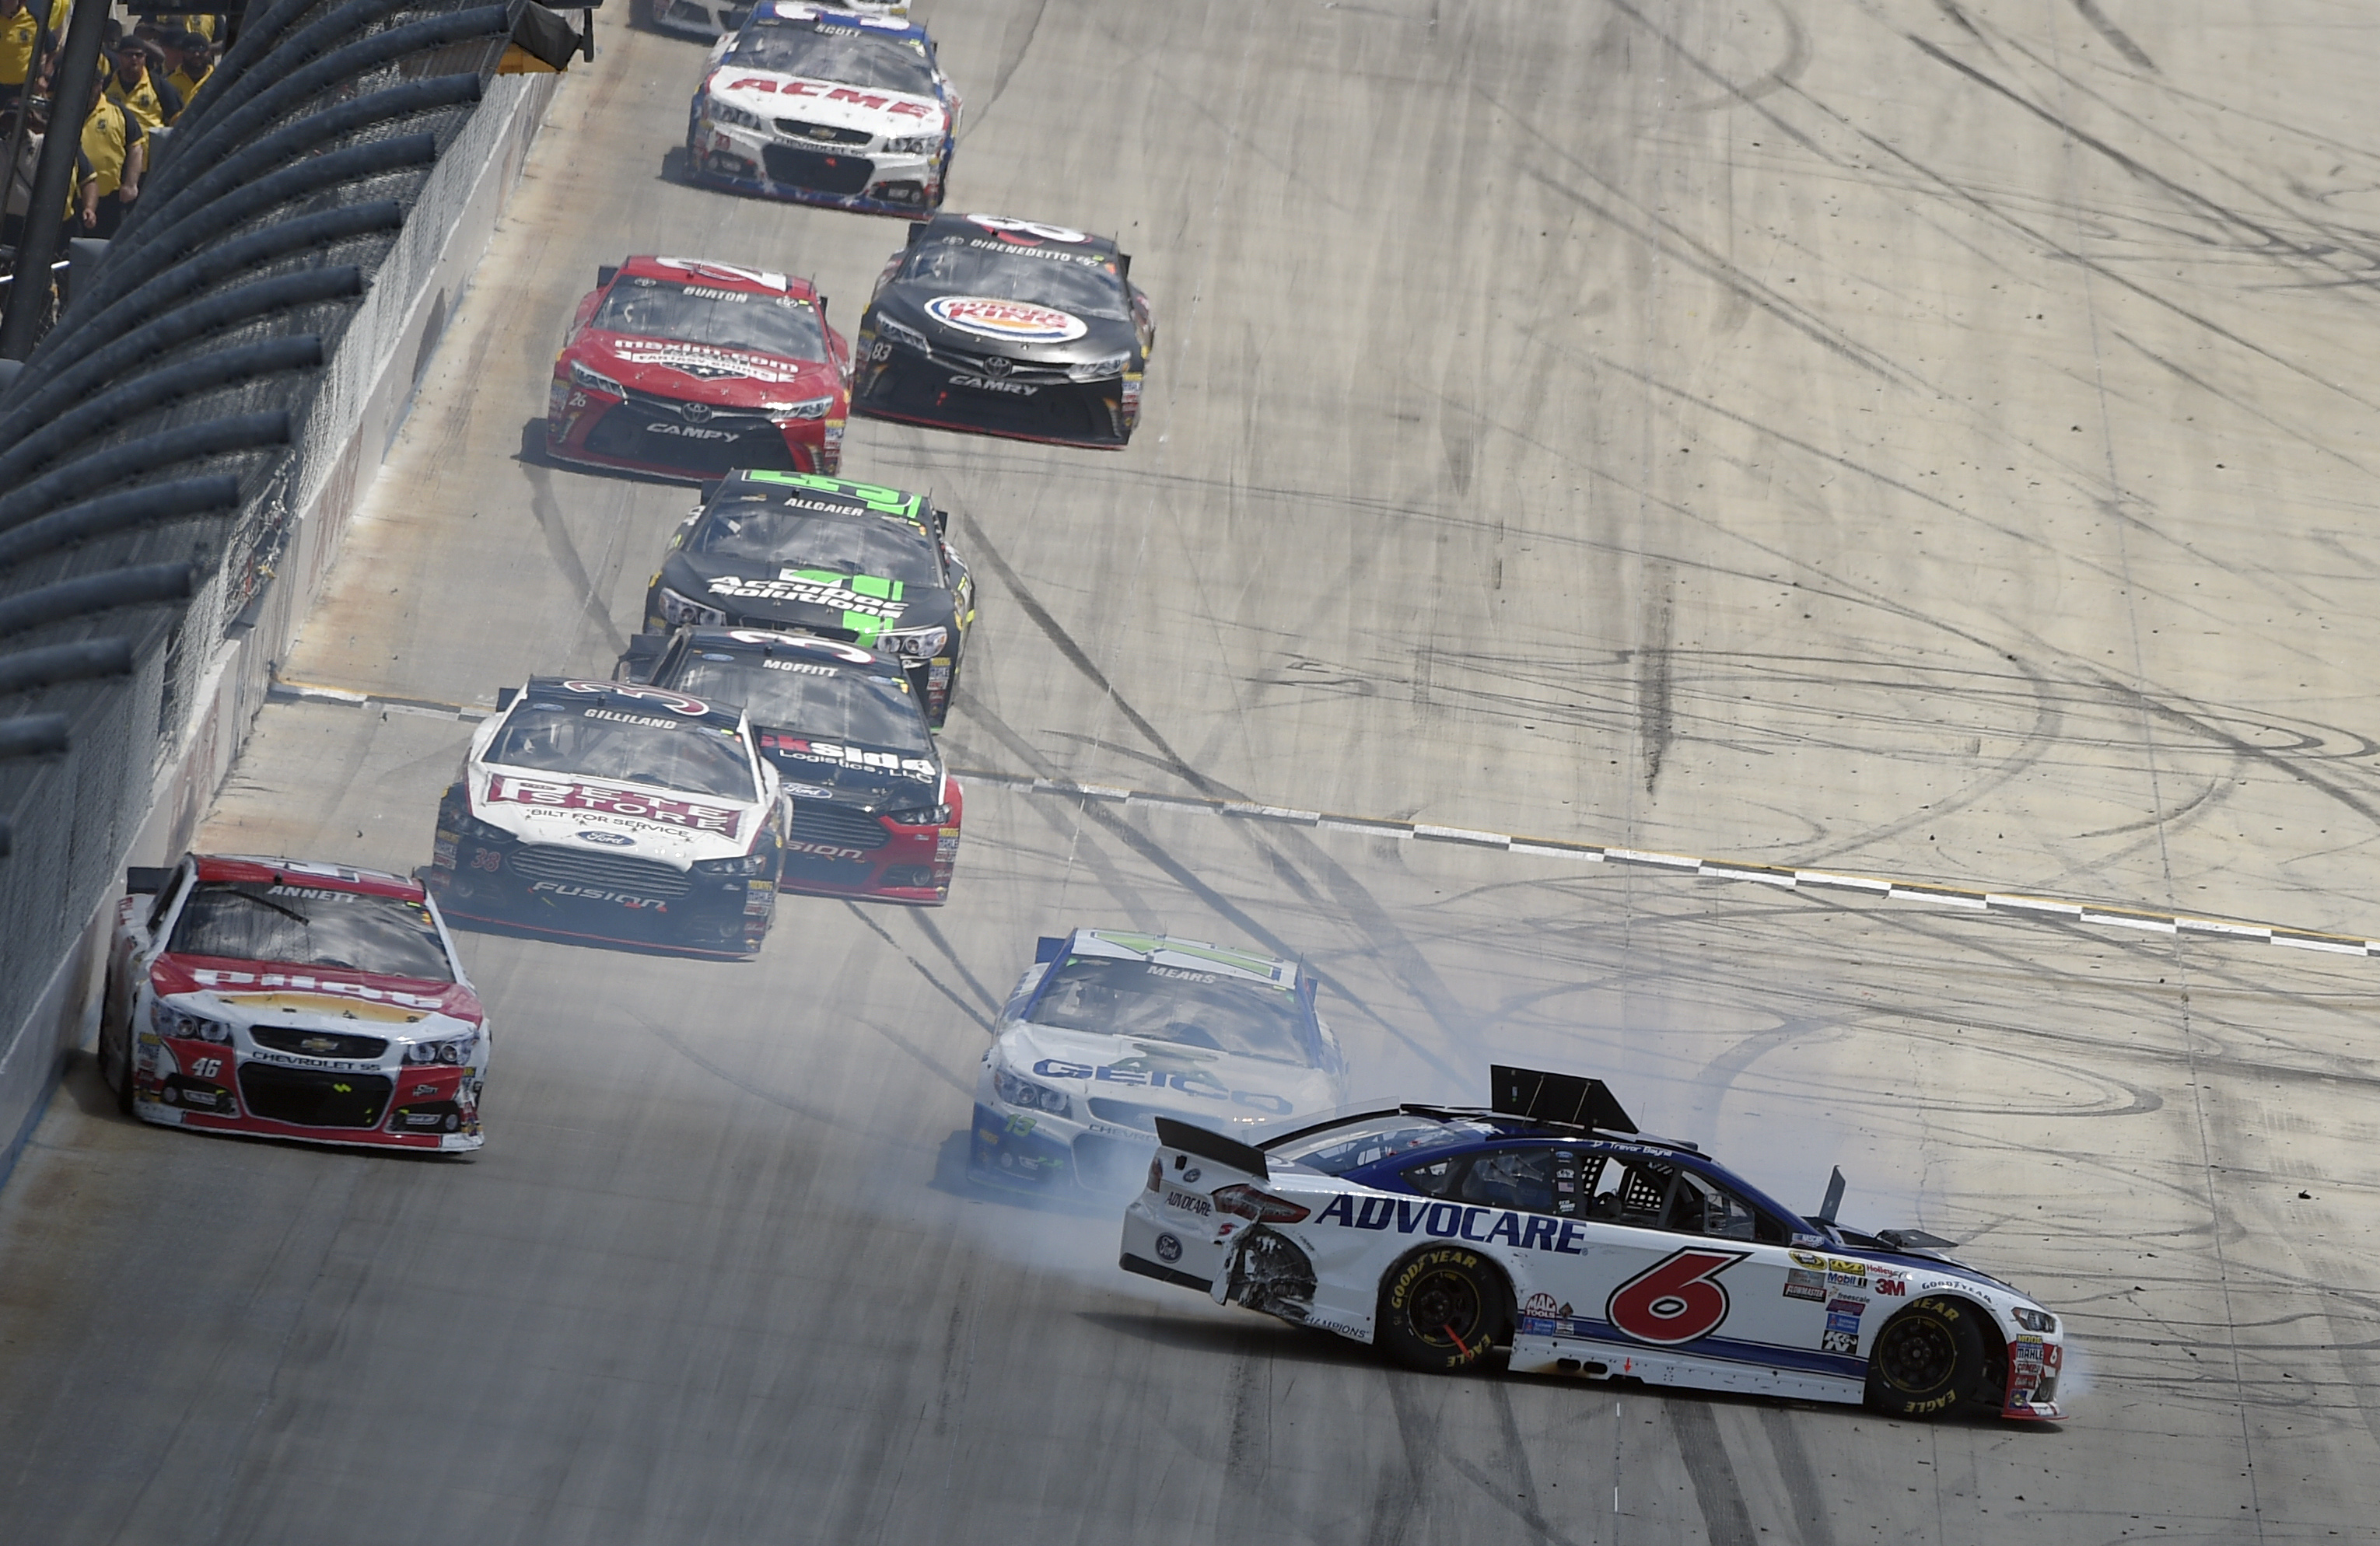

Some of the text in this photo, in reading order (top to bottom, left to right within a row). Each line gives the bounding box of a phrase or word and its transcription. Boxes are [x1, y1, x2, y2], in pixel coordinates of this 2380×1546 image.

[815, 23, 863, 37] SCOTT
[725, 78, 933, 119] ACME
[970, 237, 1071, 262] DIBENEDETTO
[683, 285, 748, 303] BURTON
[871, 342, 892, 362] 83
[948, 375, 1038, 397] CAMRY
[569, 391, 588, 407] 26
[784, 496, 865, 516] ALLGAIER
[762, 659, 838, 677] MOFFITT
[584, 708, 677, 730] GILLILAND
[889, 768, 933, 784] LLC
[499, 777, 730, 817] PETE
[530, 790, 729, 833] STORE
[572, 813, 608, 824] FOR
[471, 846, 502, 873] 38
[787, 840, 863, 859] SION
[267, 885, 359, 904] ANNETT
[532, 880, 667, 911] FUSION
[1146, 965, 1217, 985] MEARS
[191, 1057, 223, 1079] 46
[251, 1051, 382, 1072] CHEVROLET SS
[1032, 1058, 1293, 1116] GEICO
[1004, 1113, 1037, 1136] 13
[1608, 1142, 1673, 1157] Trevor Bayne
[1164, 1191, 1213, 1218] ADVOCARE
[1313, 1194, 1587, 1255] ADVOCARE
[1391, 1250, 1478, 1309] GOODYEAR
[1827, 1272, 1857, 1285] Mobil
[1867, 1264, 1893, 1278] Holley
[1605, 1246, 1755, 1345] 6
[1874, 1278, 1906, 1296] 3M
[1921, 1281, 1993, 1304] GOODYEAR
[1527, 1294, 1556, 1313] MAC
[1837, 1292, 1871, 1303] freescale
[1527, 1310, 1556, 1319] TOOLS
[1912, 1298, 1960, 1321] YEAR
[2018, 1334, 2042, 1345] MOOG
[2017, 1348, 2044, 1360] MAHLE
[2049, 1345, 2059, 1365] 6
[1904, 1388, 1957, 1413] EAGLE
